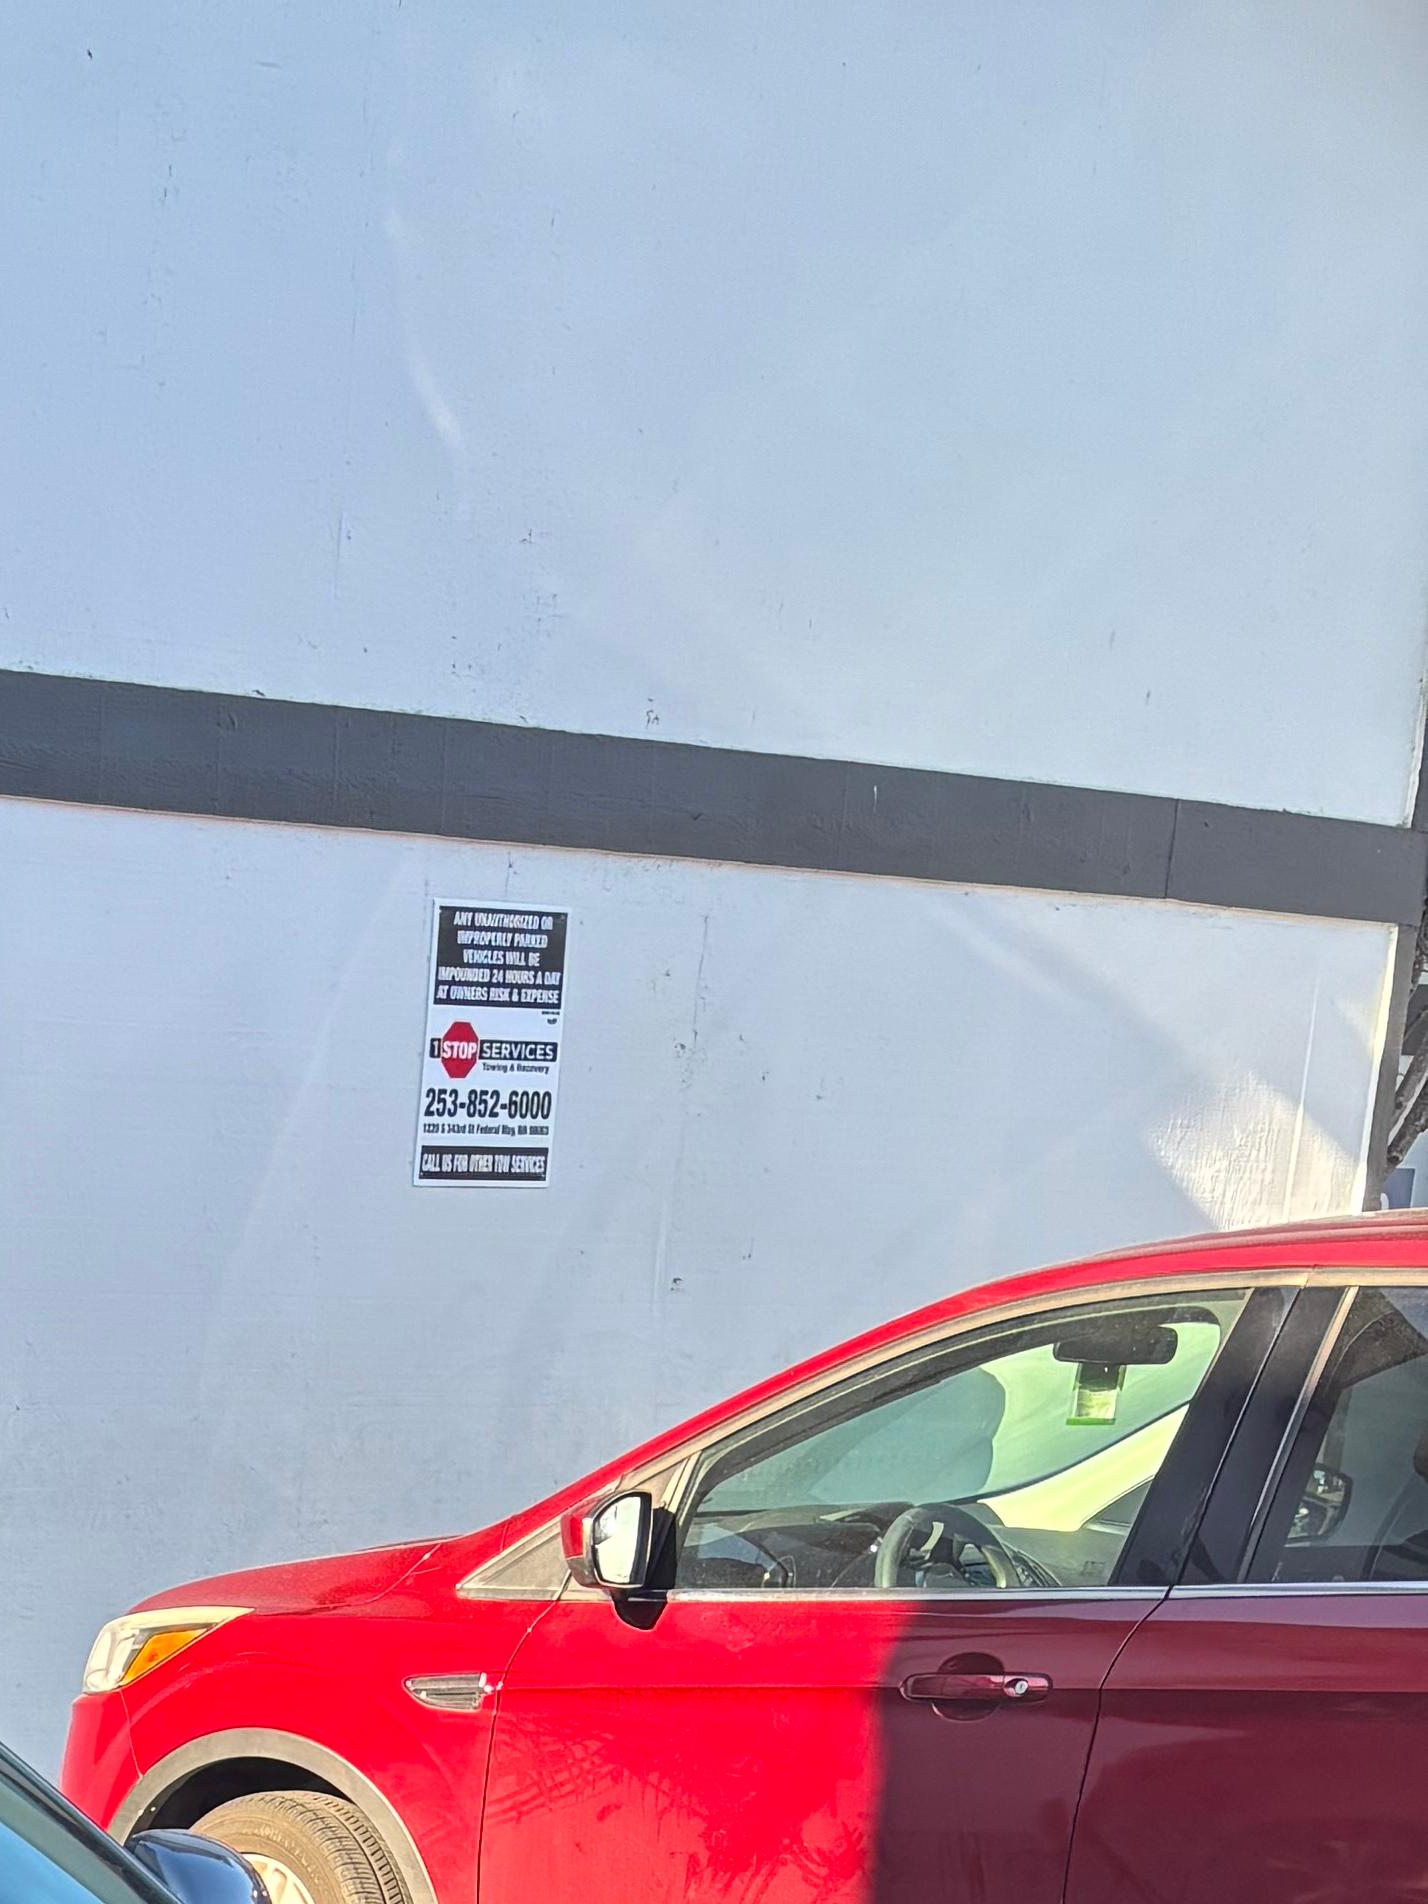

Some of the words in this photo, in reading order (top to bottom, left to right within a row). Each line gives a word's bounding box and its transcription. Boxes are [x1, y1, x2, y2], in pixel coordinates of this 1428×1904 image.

[453, 911, 473, 926] ANY
[462, 948, 504, 965] VEHICLES
[505, 951, 526, 966] WILL
[528, 953, 541, 967] BE
[438, 966, 490, 983] IMPOUNDED
[492, 969, 504, 984] 24
[505, 970, 535, 985] HOURS
[536, 972, 543, 985] A
[544, 972, 562, 986] DAY
[436, 985, 449, 999] AT
[450, 986, 488, 1000] OWNERS
[489, 987, 511, 1002] RISK
[511, 989, 519, 1002] &
[520, 989, 560, 1004] EXPENSE
[432, 1041, 439, 1056] 1
[441, 1041, 477, 1059] STOP
[481, 1042, 554, 1060] SERVICES
[482, 1062, 508, 1074] Towing
[516, 1064, 550, 1075] Recovery
[424, 1087, 552, 1120] 253-852-6000
[476, 1124, 500, 1135] Federal
[422, 1153, 441, 1172] CALL
[441, 1154, 453, 1172] US
[453, 1154, 469, 1172] FOR
[469, 1154, 493, 1173] OTHER
[494, 1155, 511, 1173] TOW
[511, 1155, 545, 1174] SERVICES
